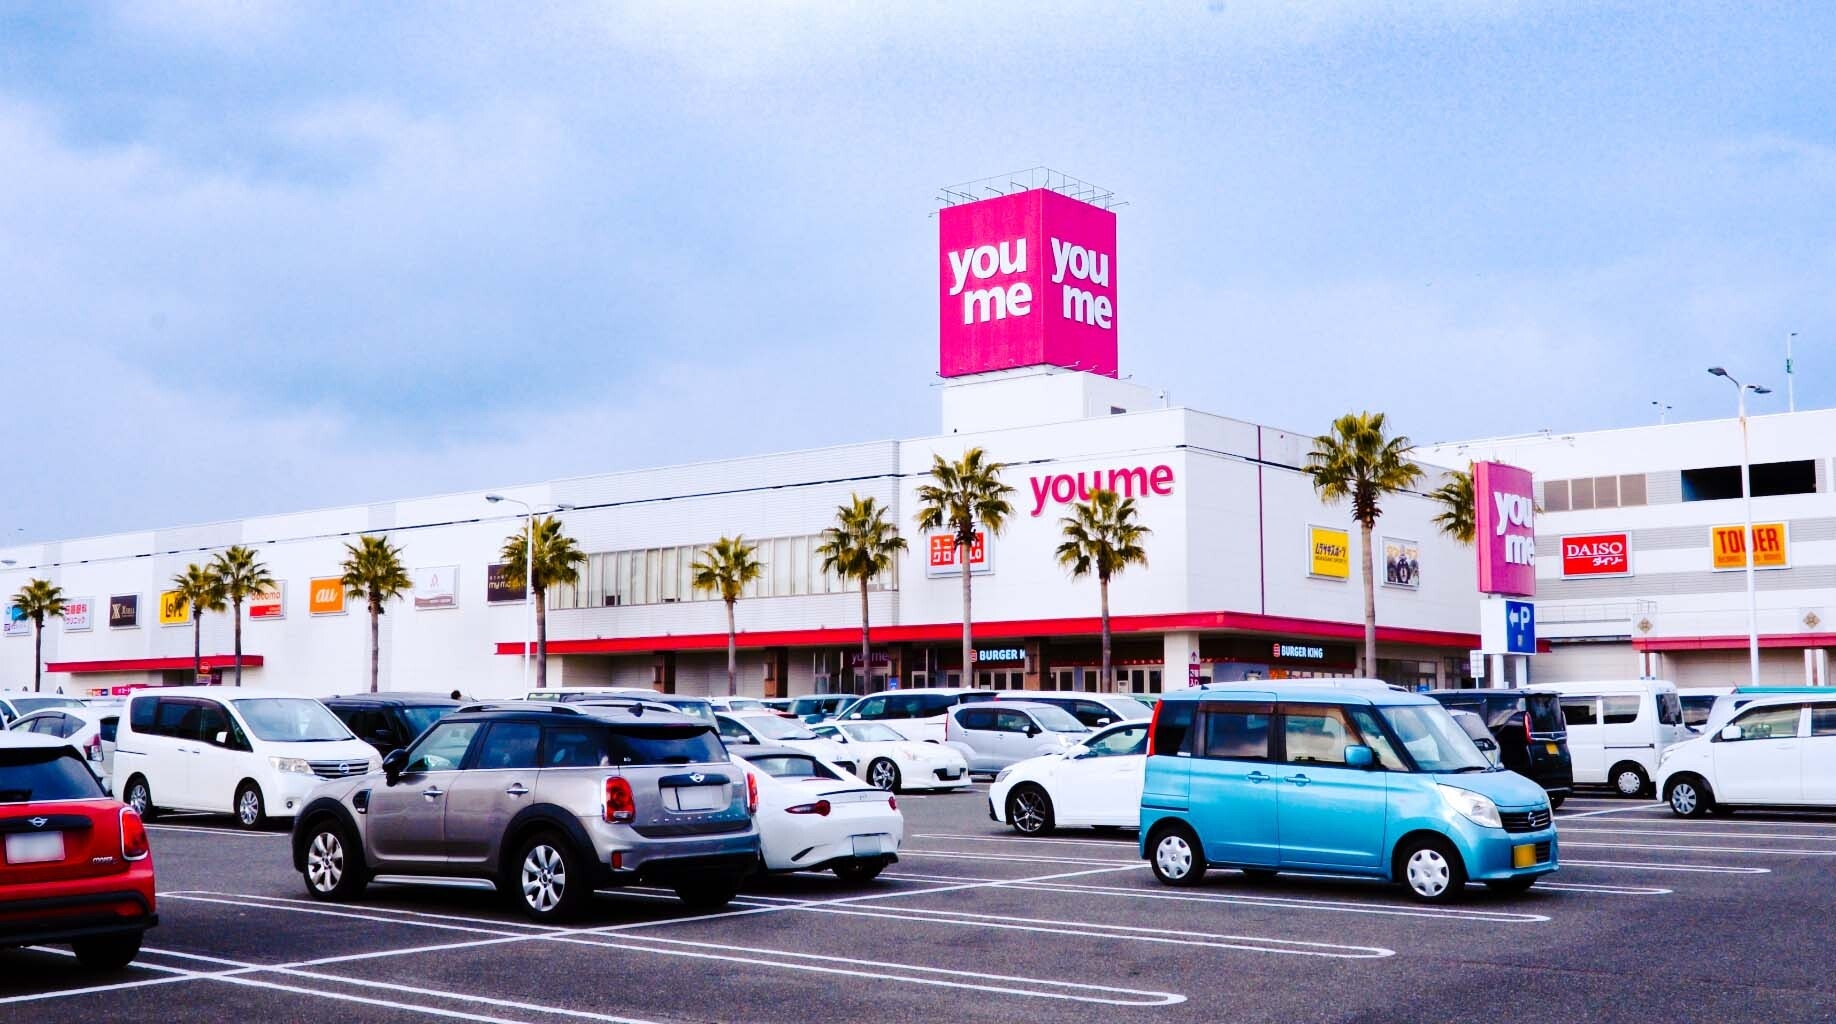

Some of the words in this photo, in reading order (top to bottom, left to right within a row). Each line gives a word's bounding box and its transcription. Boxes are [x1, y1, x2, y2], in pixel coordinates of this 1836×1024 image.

[948, 238, 1028, 296] you
[1050, 237, 1109, 288] you
[963, 283, 1033, 325] me
[1063, 284, 1113, 329] me
[1493, 490, 1533, 536] you
[1567, 542, 1623, 557] DAISO
[315, 588, 338, 603] au
[1520, 606, 1531, 631] P
[979, 649, 1018, 661] BURGER
[1281, 645, 1307, 657] BURGER
[1307, 647, 1323, 659] KING
